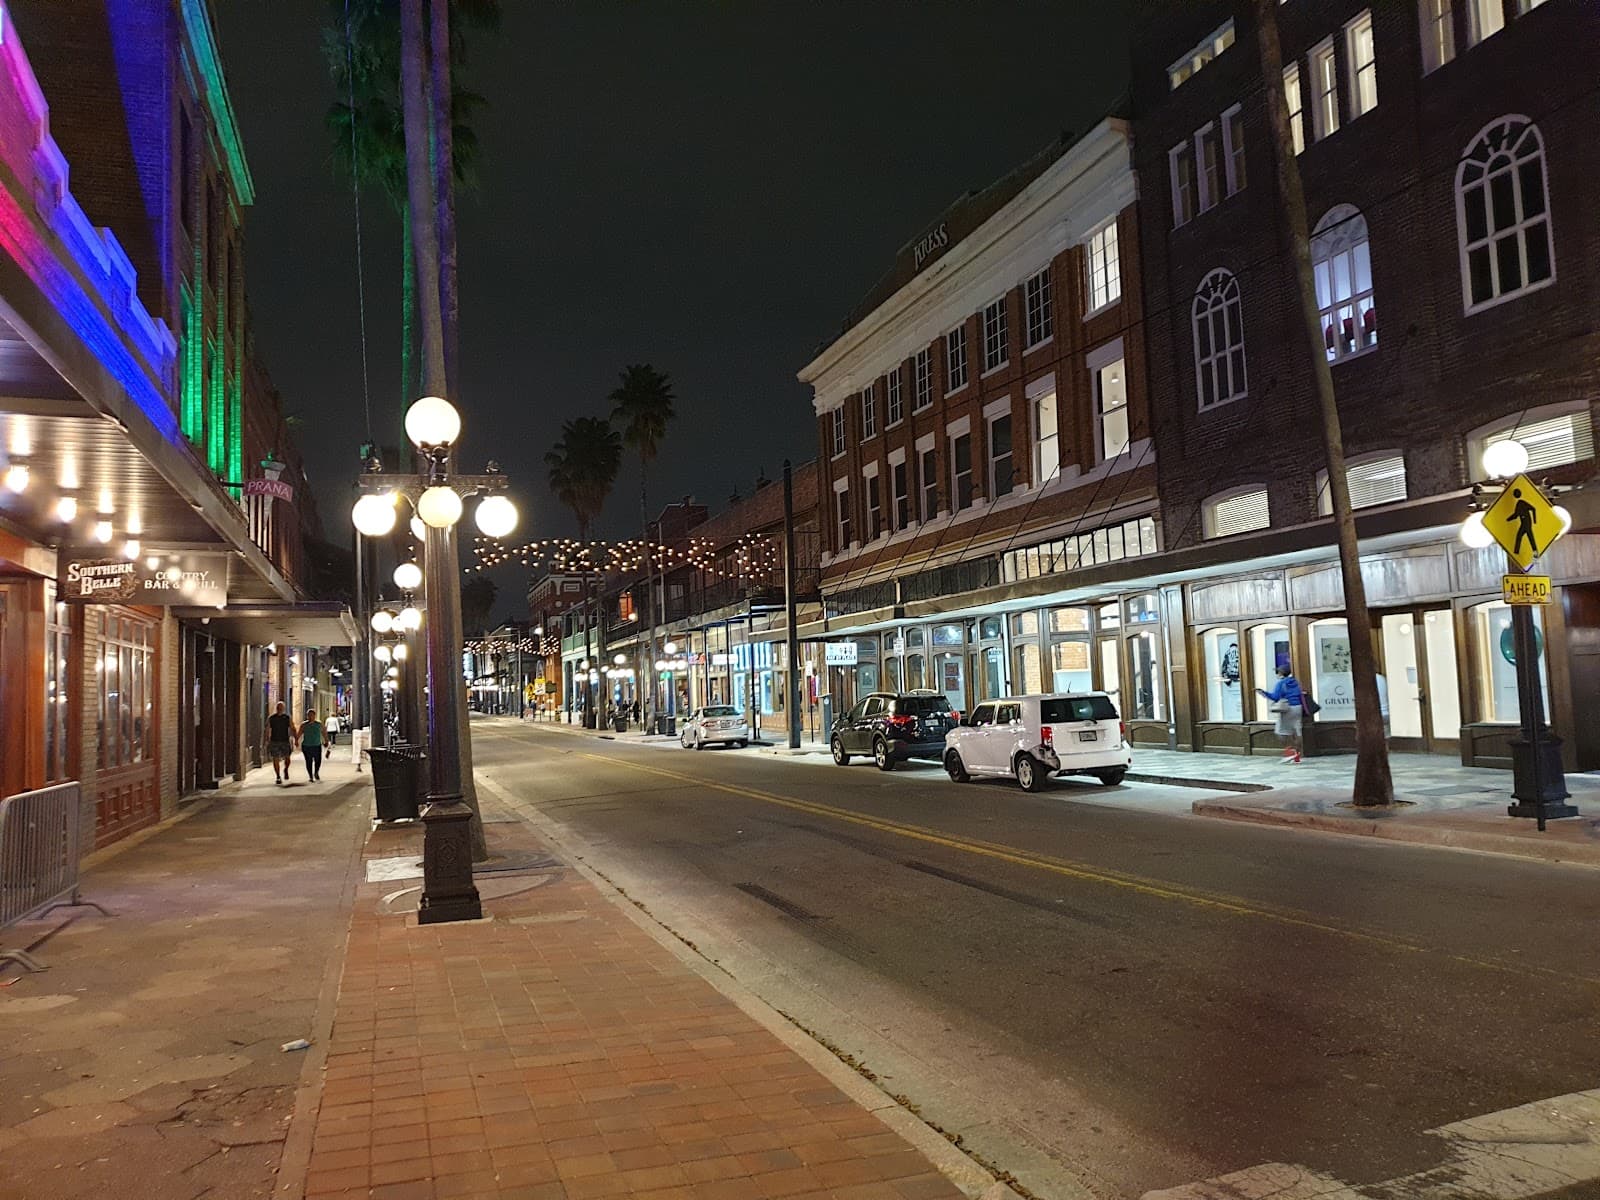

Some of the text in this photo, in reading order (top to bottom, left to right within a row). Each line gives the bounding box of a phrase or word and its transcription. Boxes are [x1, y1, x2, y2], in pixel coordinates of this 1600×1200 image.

[914, 223, 948, 271] KRESS
[248, 480, 290, 498] PRANA
[155, 571, 209, 581] CONTRY
[144, 580, 218, 590] BAR & RILL
[1510, 583, 1546, 596] AHEAD
